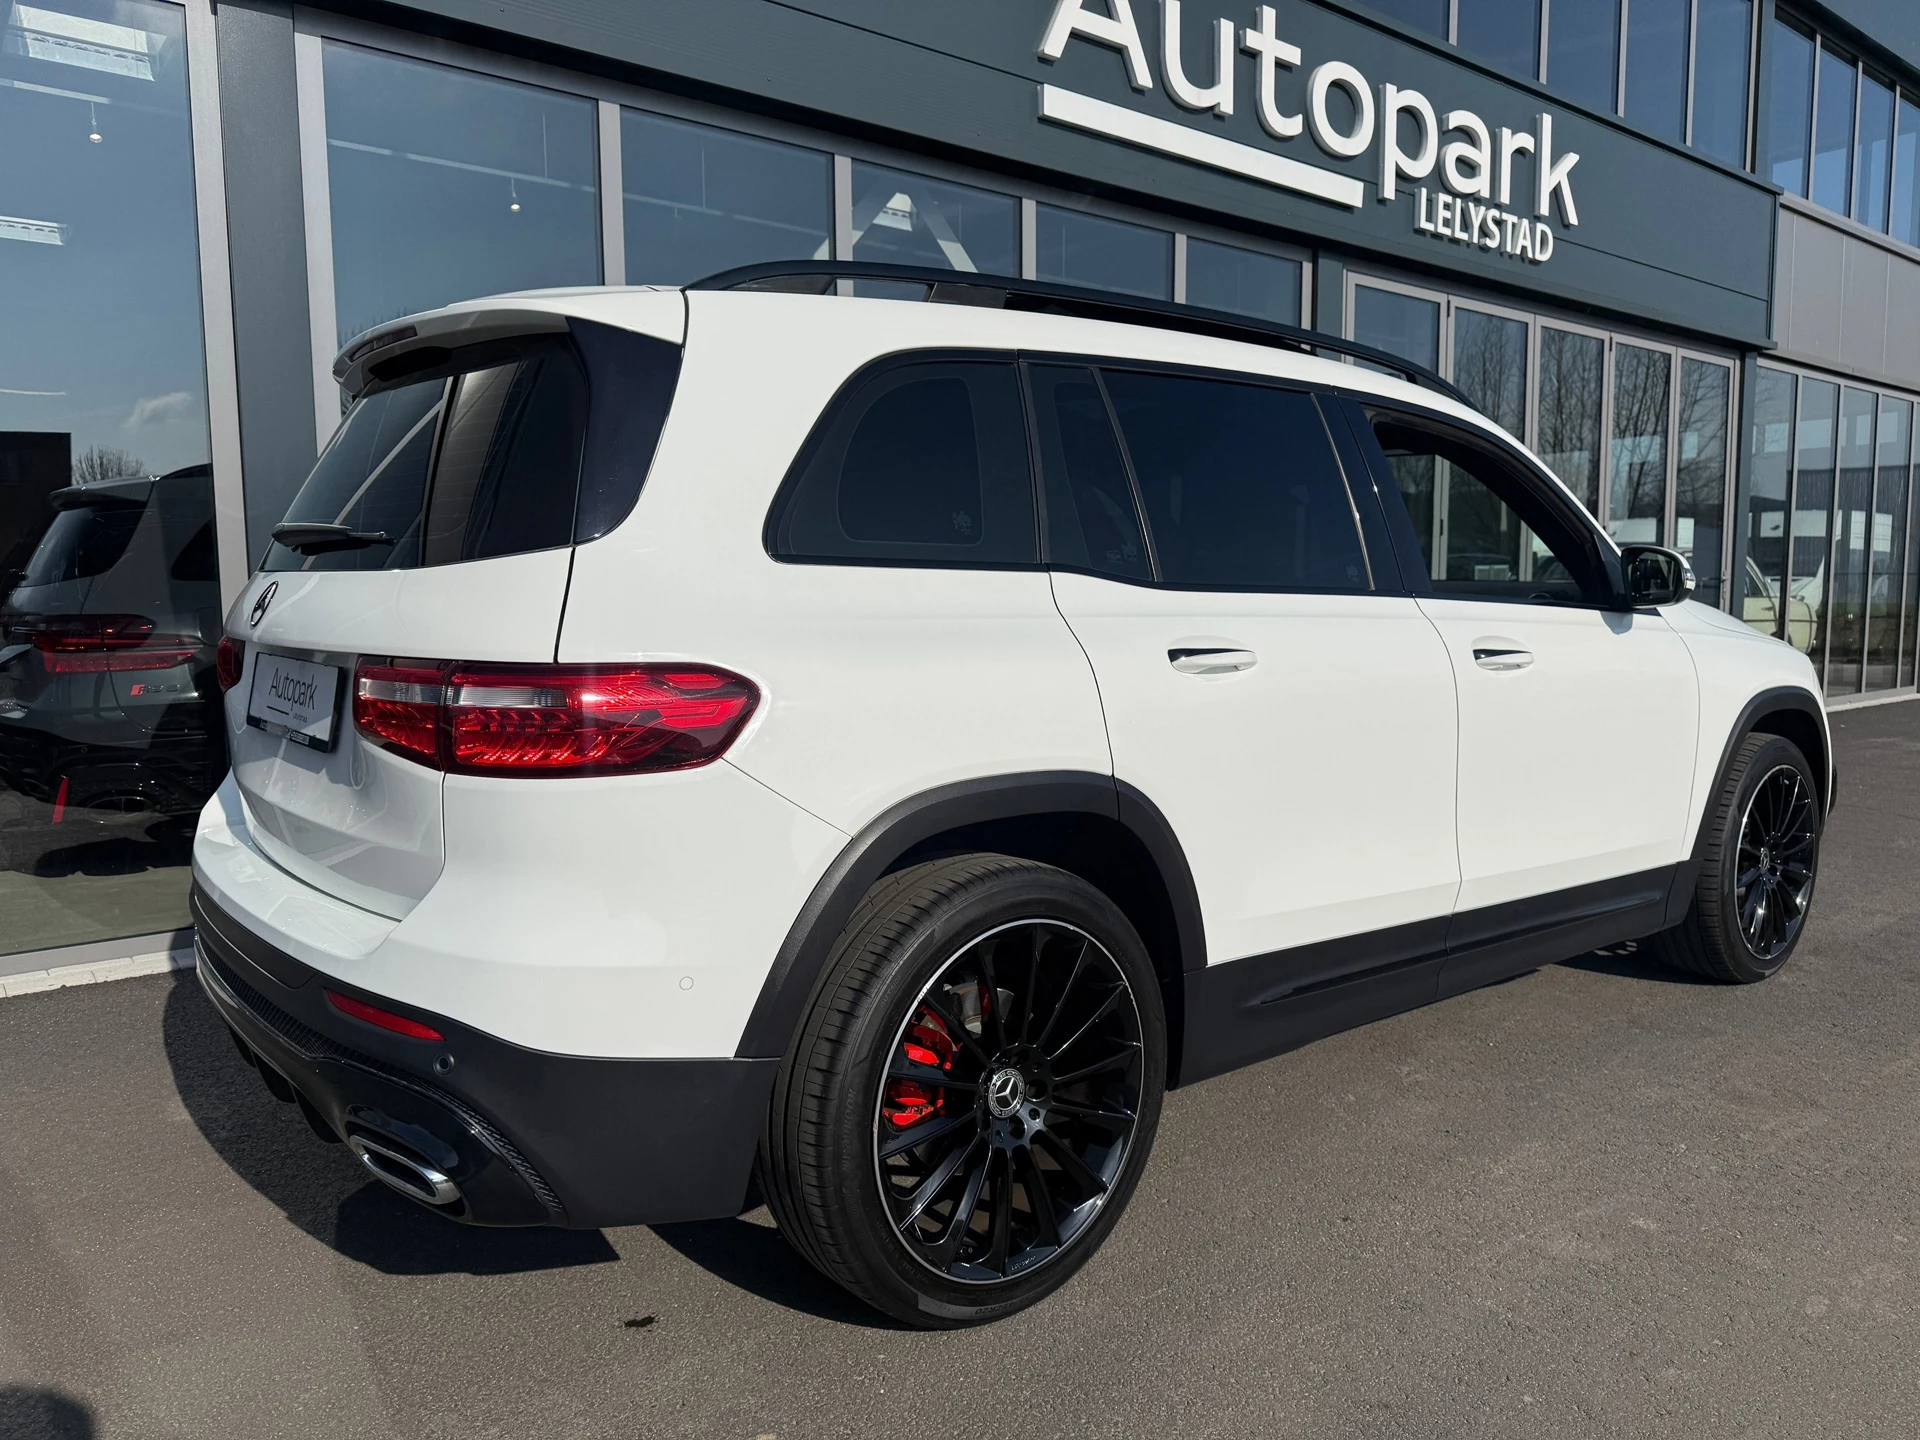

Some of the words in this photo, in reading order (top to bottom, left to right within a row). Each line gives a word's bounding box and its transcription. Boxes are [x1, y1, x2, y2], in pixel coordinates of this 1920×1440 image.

[1037, 0, 1580, 227] Autopark
[1415, 187, 1554, 262] LELYSTAD
[268, 666, 318, 711] Autopark
